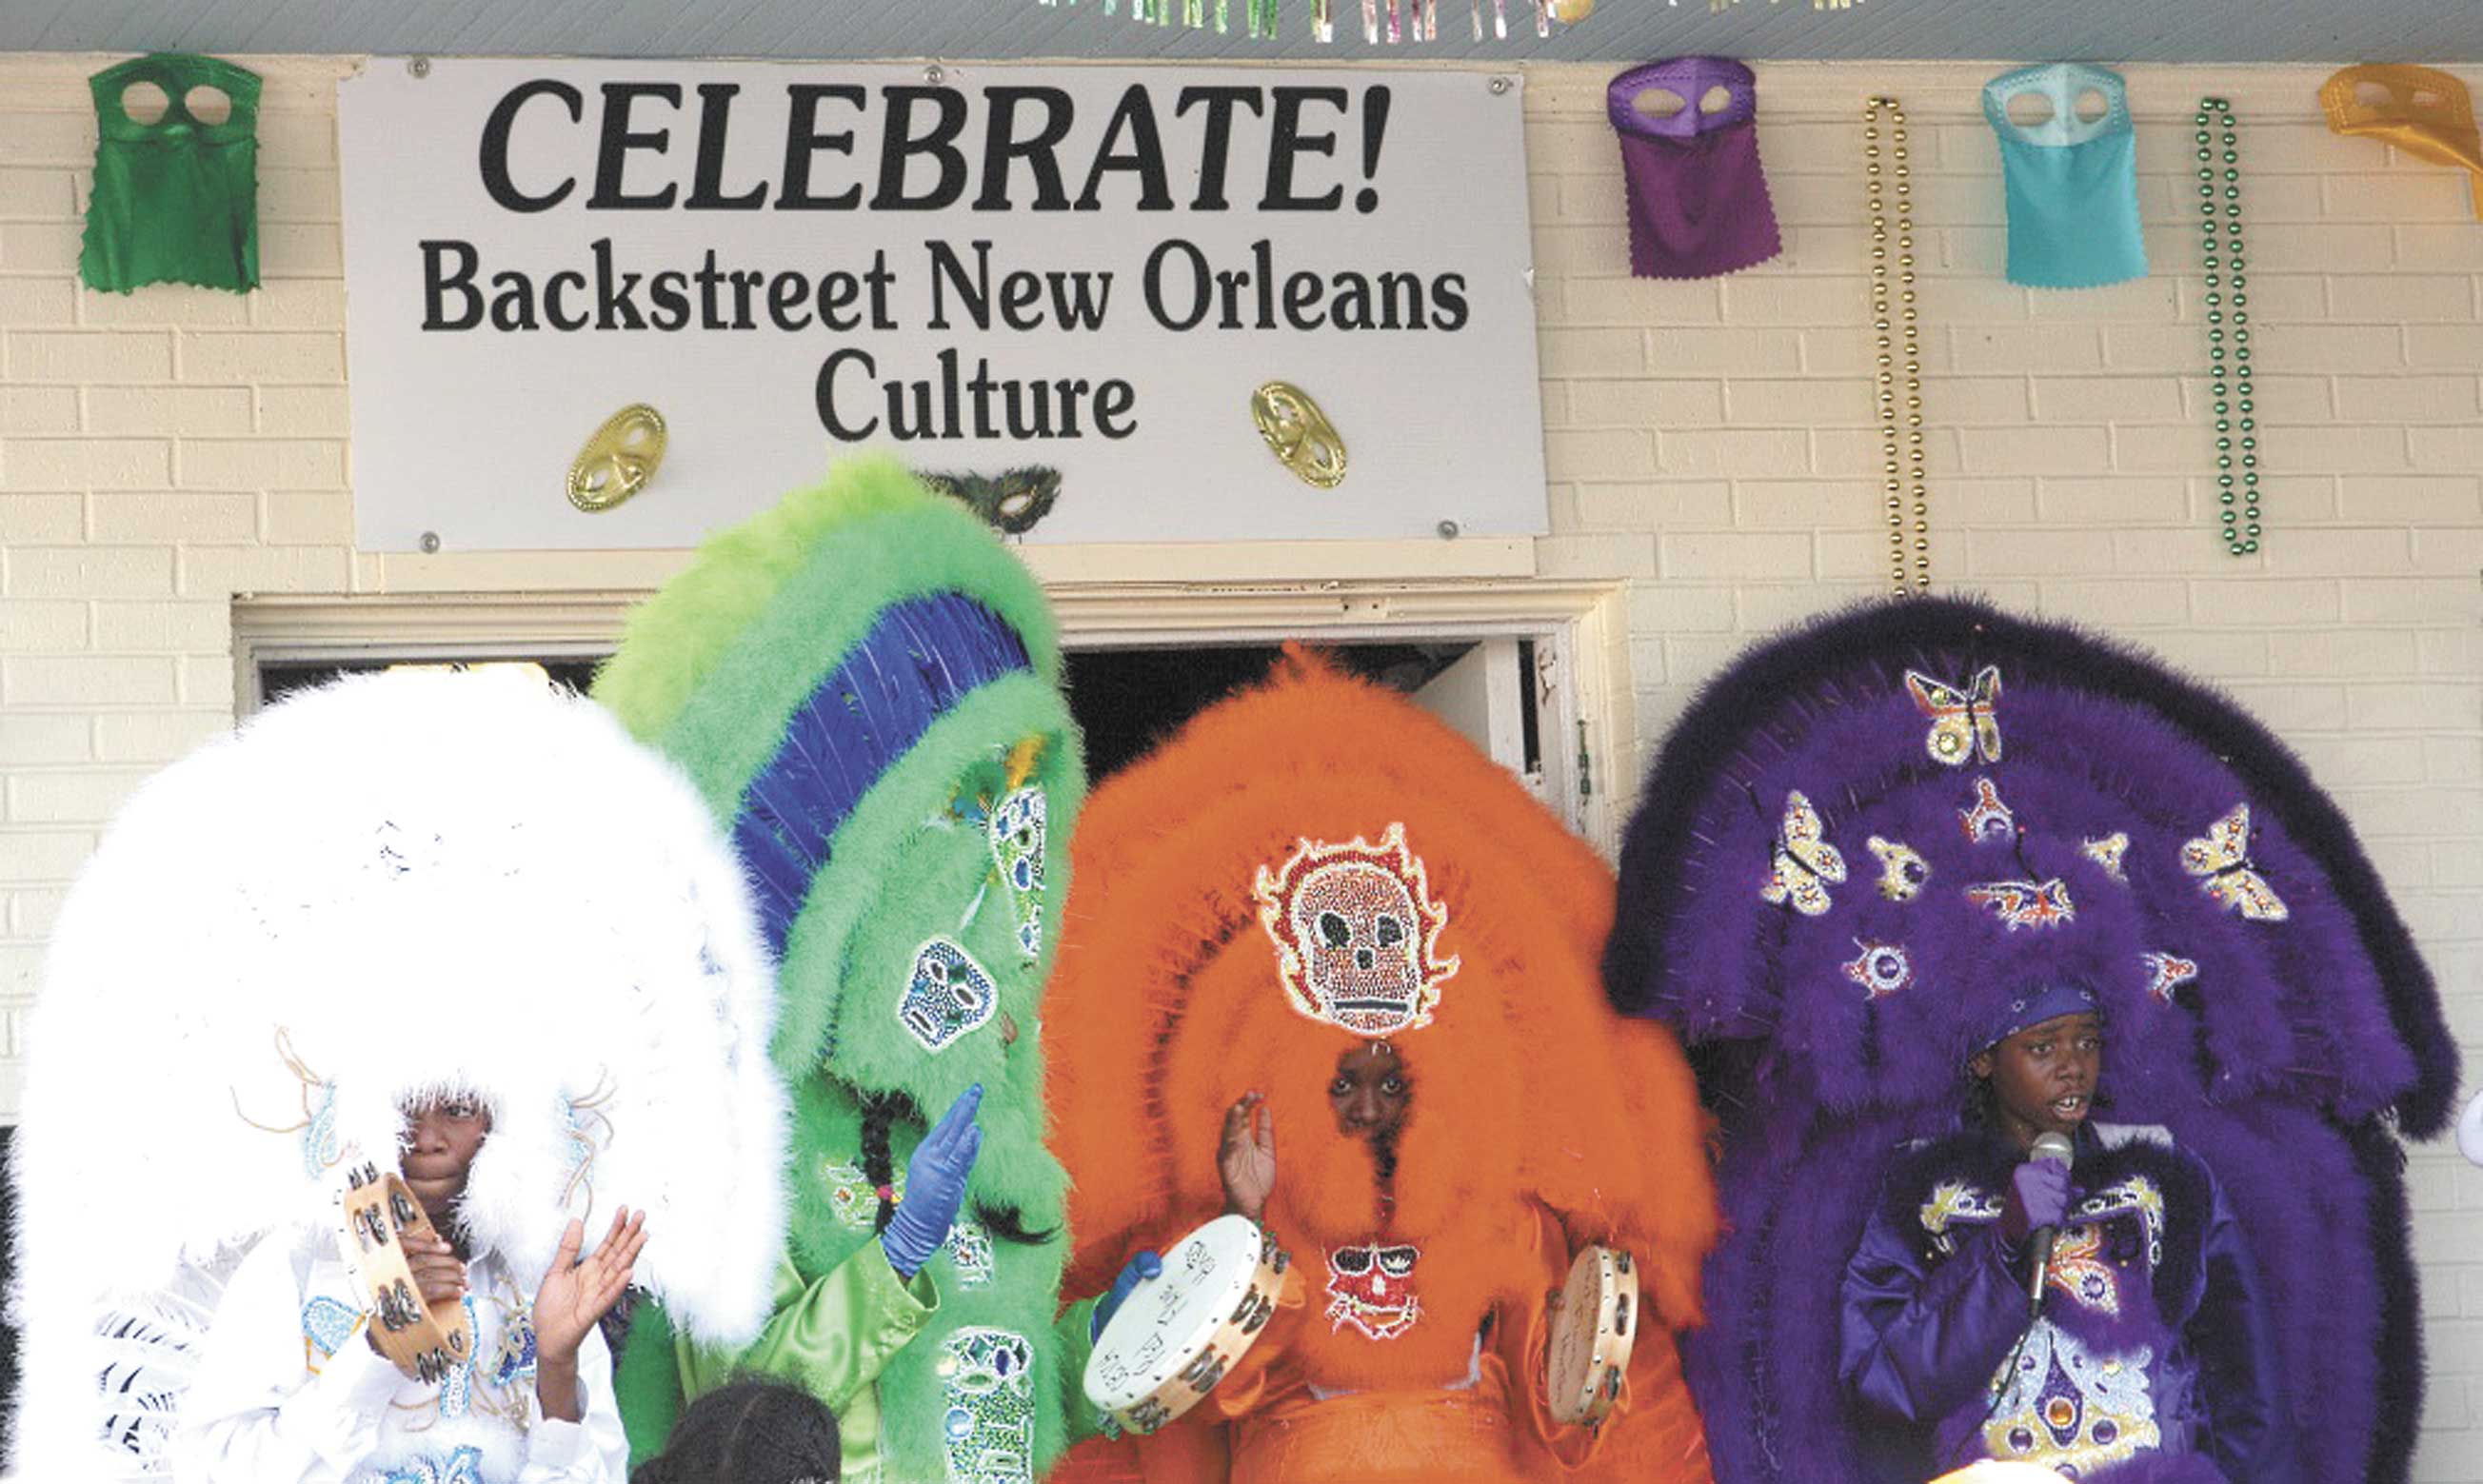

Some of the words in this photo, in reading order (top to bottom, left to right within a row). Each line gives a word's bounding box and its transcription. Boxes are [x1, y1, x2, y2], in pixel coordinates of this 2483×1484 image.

[479, 80, 1391, 214] CELEBRATE!
[420, 238, 897, 332] Backstreet
[925, 240, 1113, 331] New
[1142, 238, 1468, 332] Orleans
[816, 348, 1137, 443] Culture
